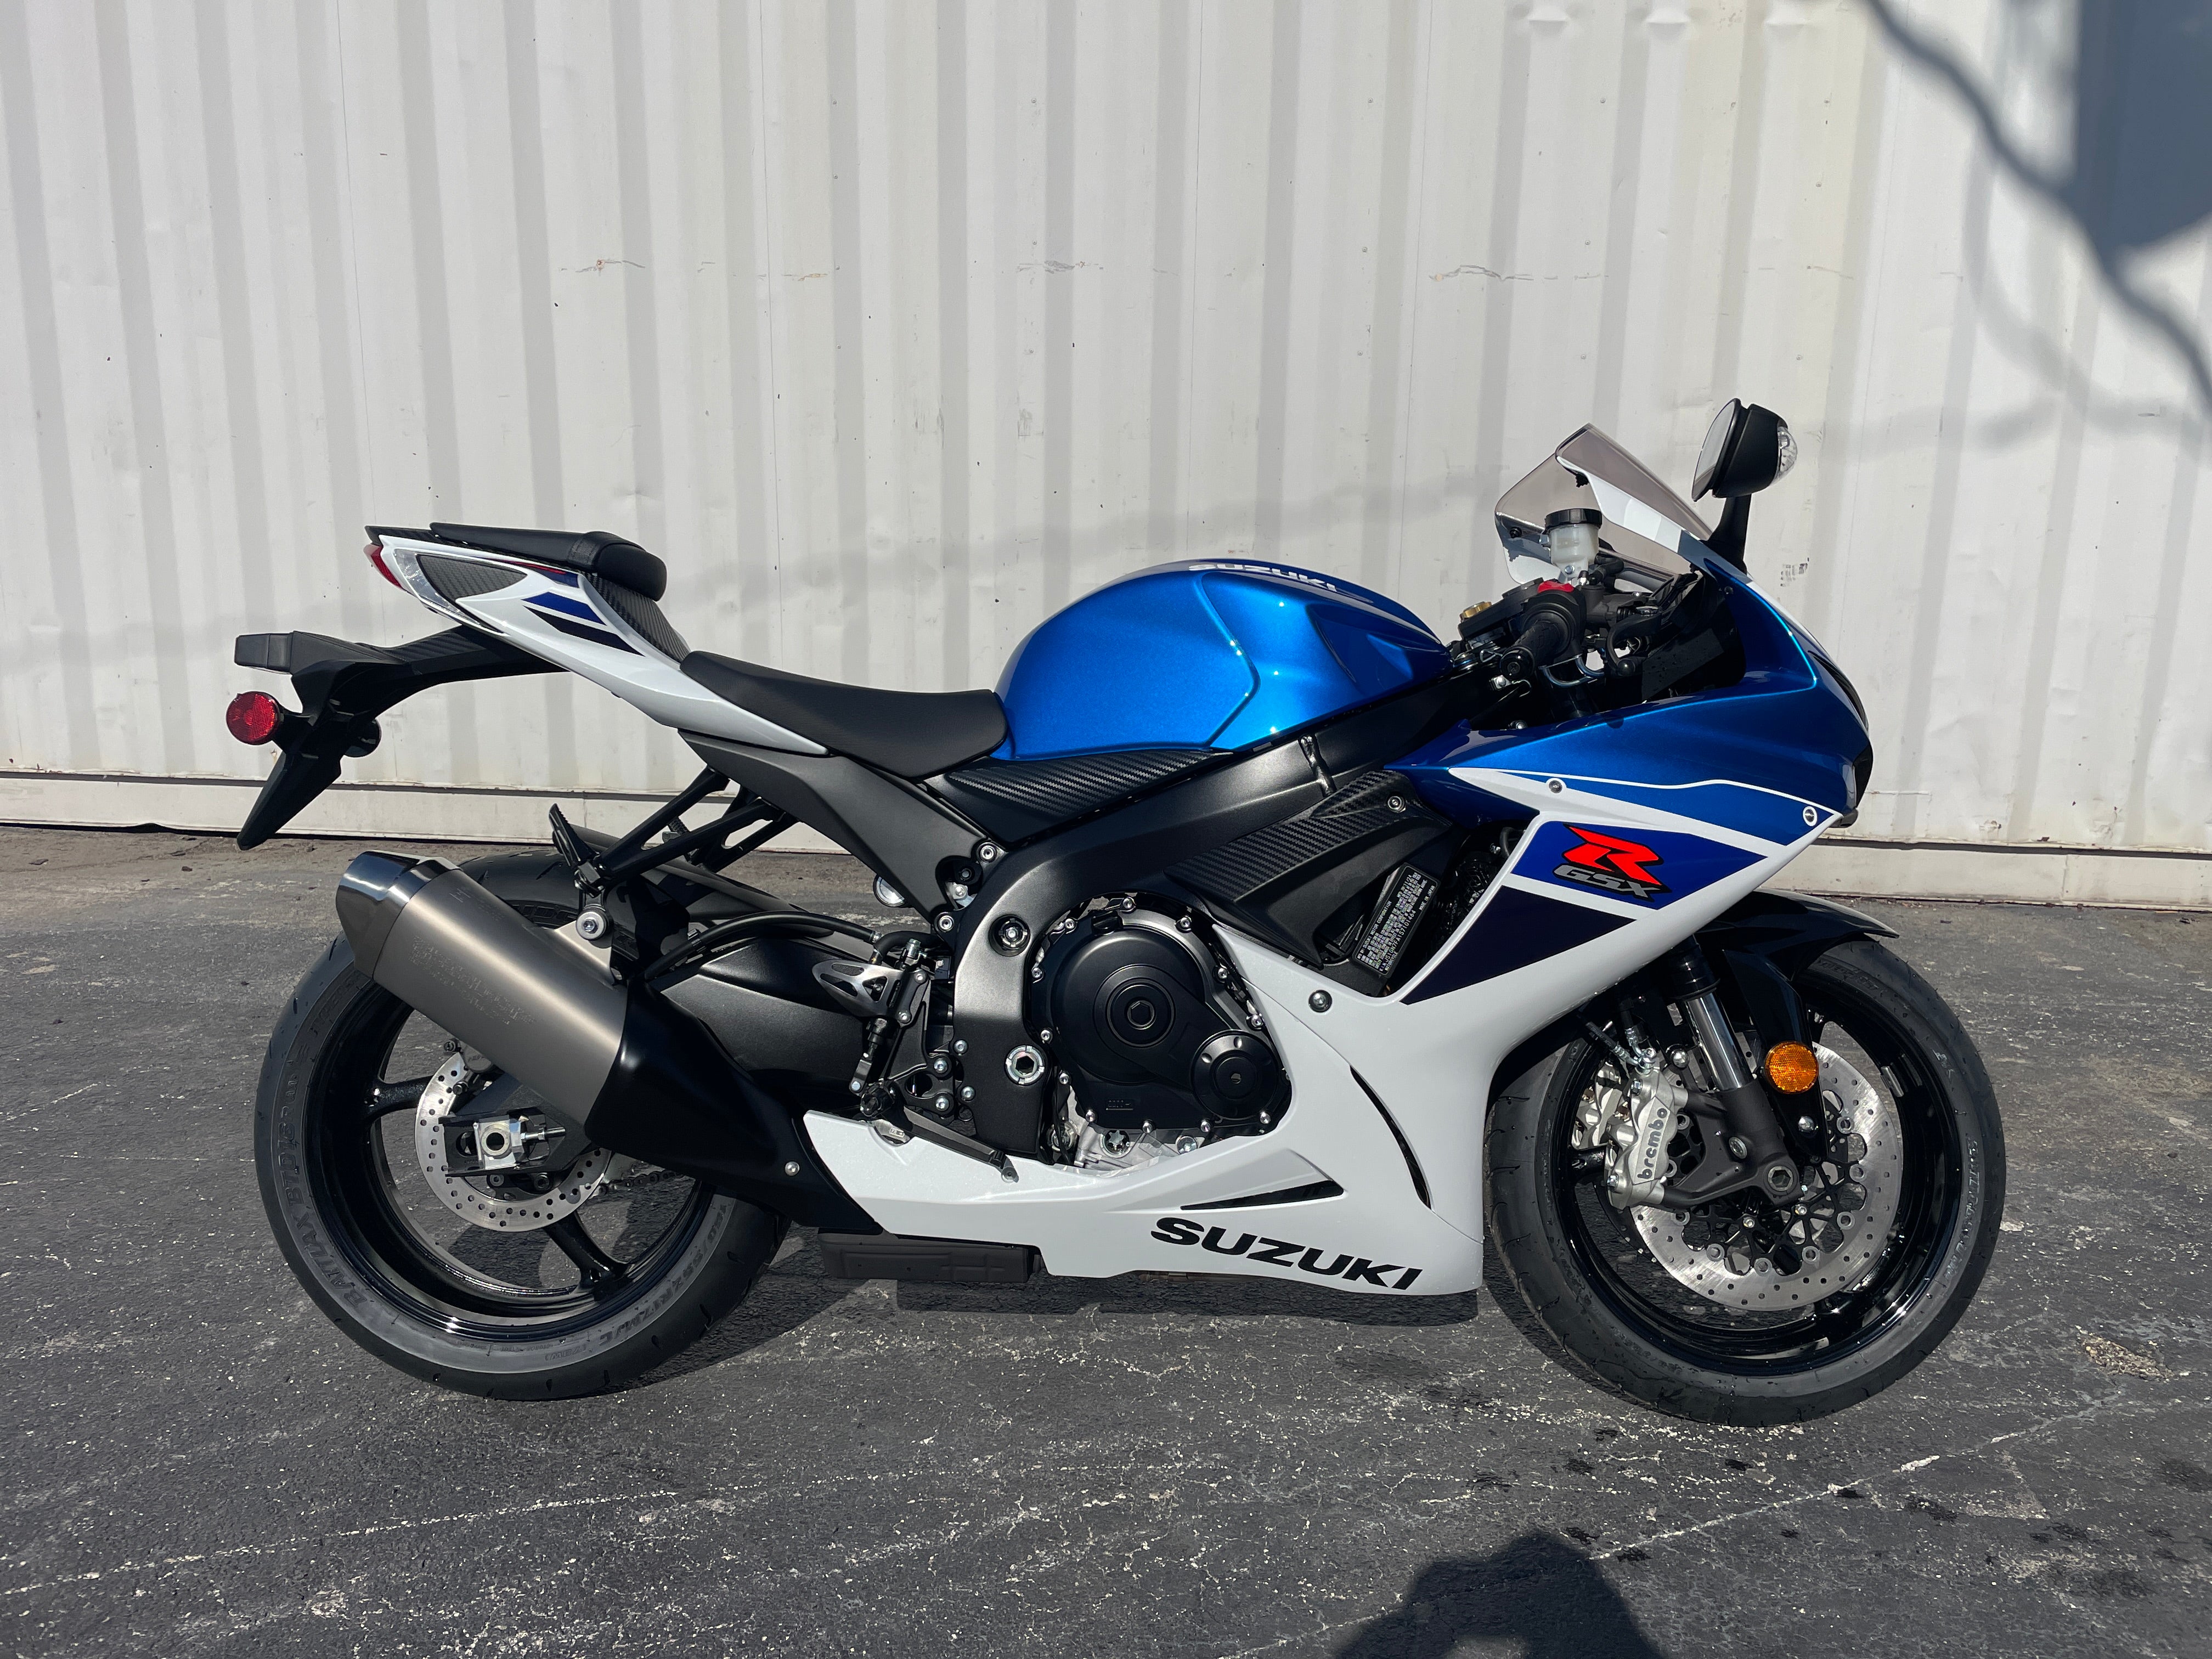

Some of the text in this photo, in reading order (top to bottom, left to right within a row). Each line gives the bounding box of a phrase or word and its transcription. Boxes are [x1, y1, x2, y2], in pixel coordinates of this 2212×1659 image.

[1188, 563, 1338, 592] SUZUKI
[1554, 865, 1661, 898] GSX
[1563, 826, 1662, 886] R
[1637, 1107, 1669, 1180] brembo
[1150, 1216, 1423, 1290] SUZUKI
